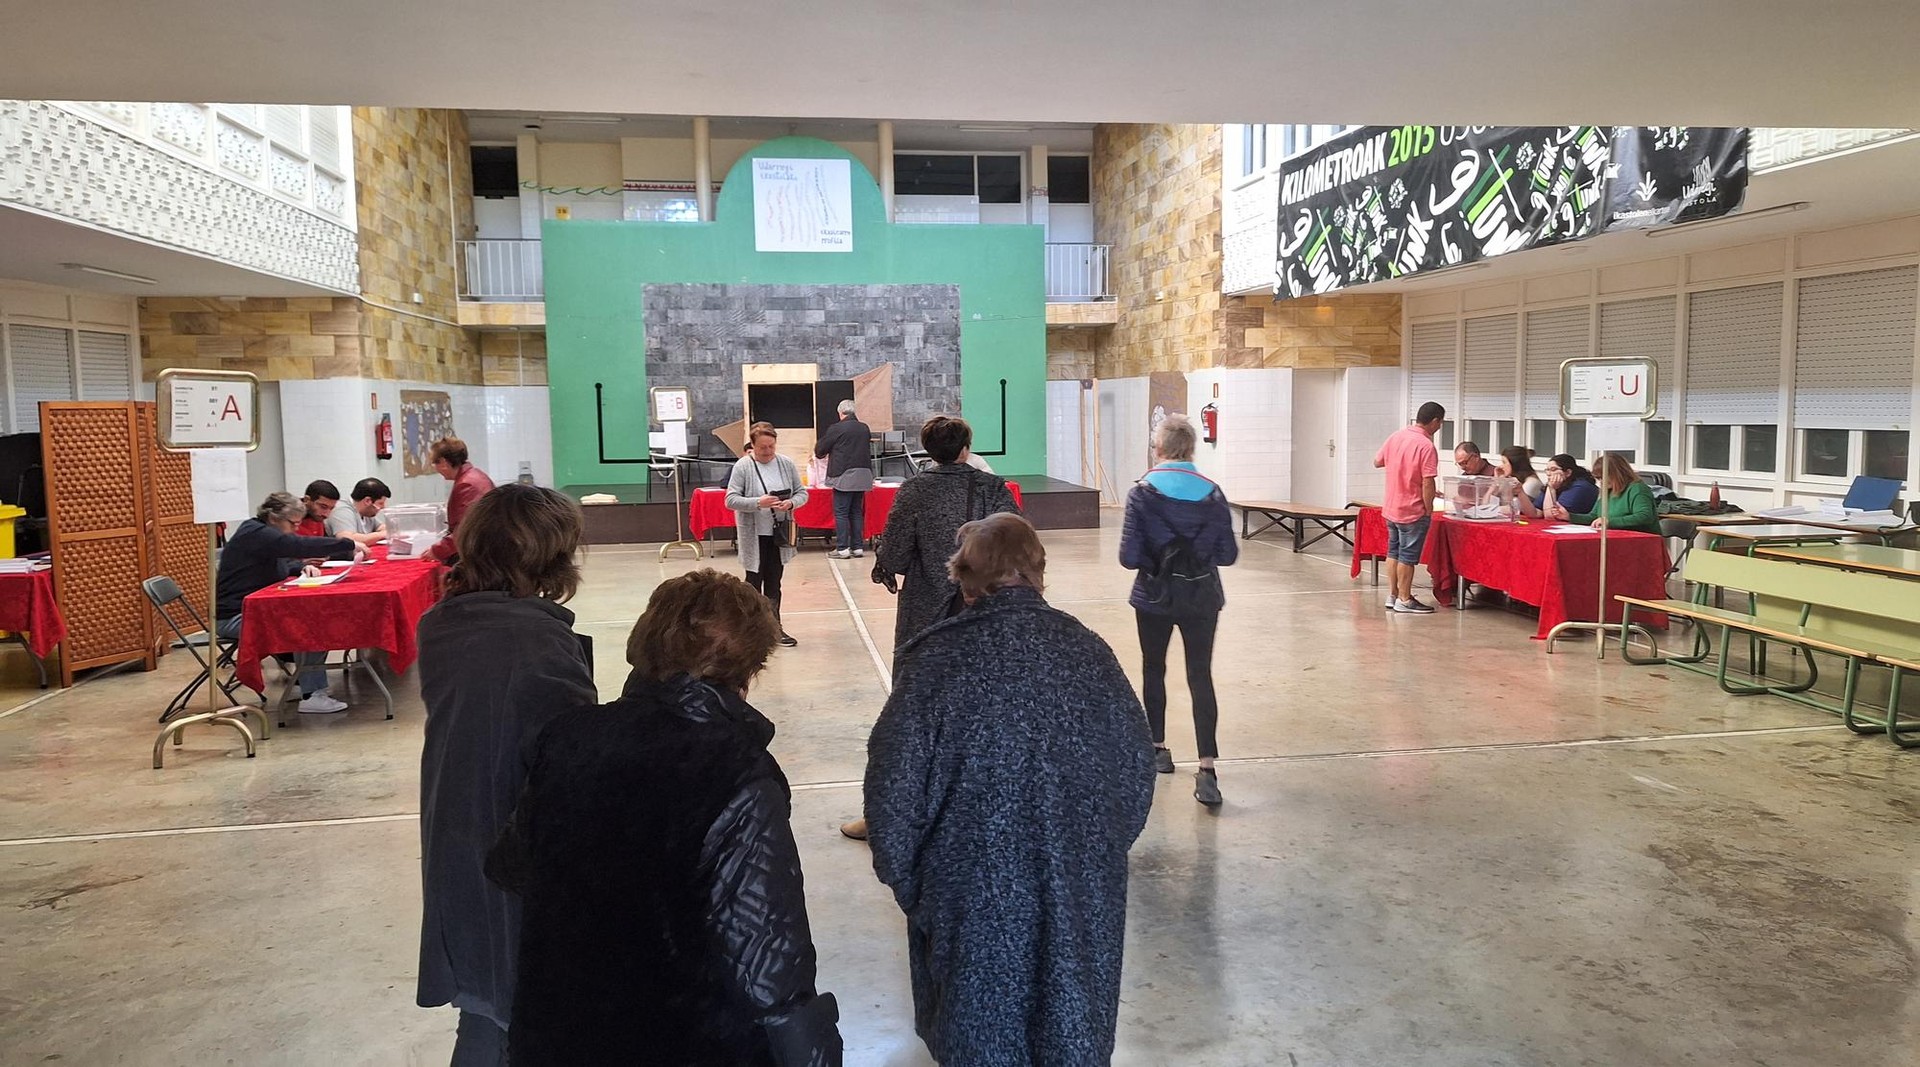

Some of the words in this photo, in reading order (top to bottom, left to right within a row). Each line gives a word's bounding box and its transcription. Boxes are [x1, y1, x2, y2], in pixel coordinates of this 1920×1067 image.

[1281, 131, 1388, 206] KILOMETROAK
[1387, 125, 1436, 168] 2015
[1620, 374, 1639, 396] U
[220, 394, 242, 421] A
[676, 397, 684, 409] B
